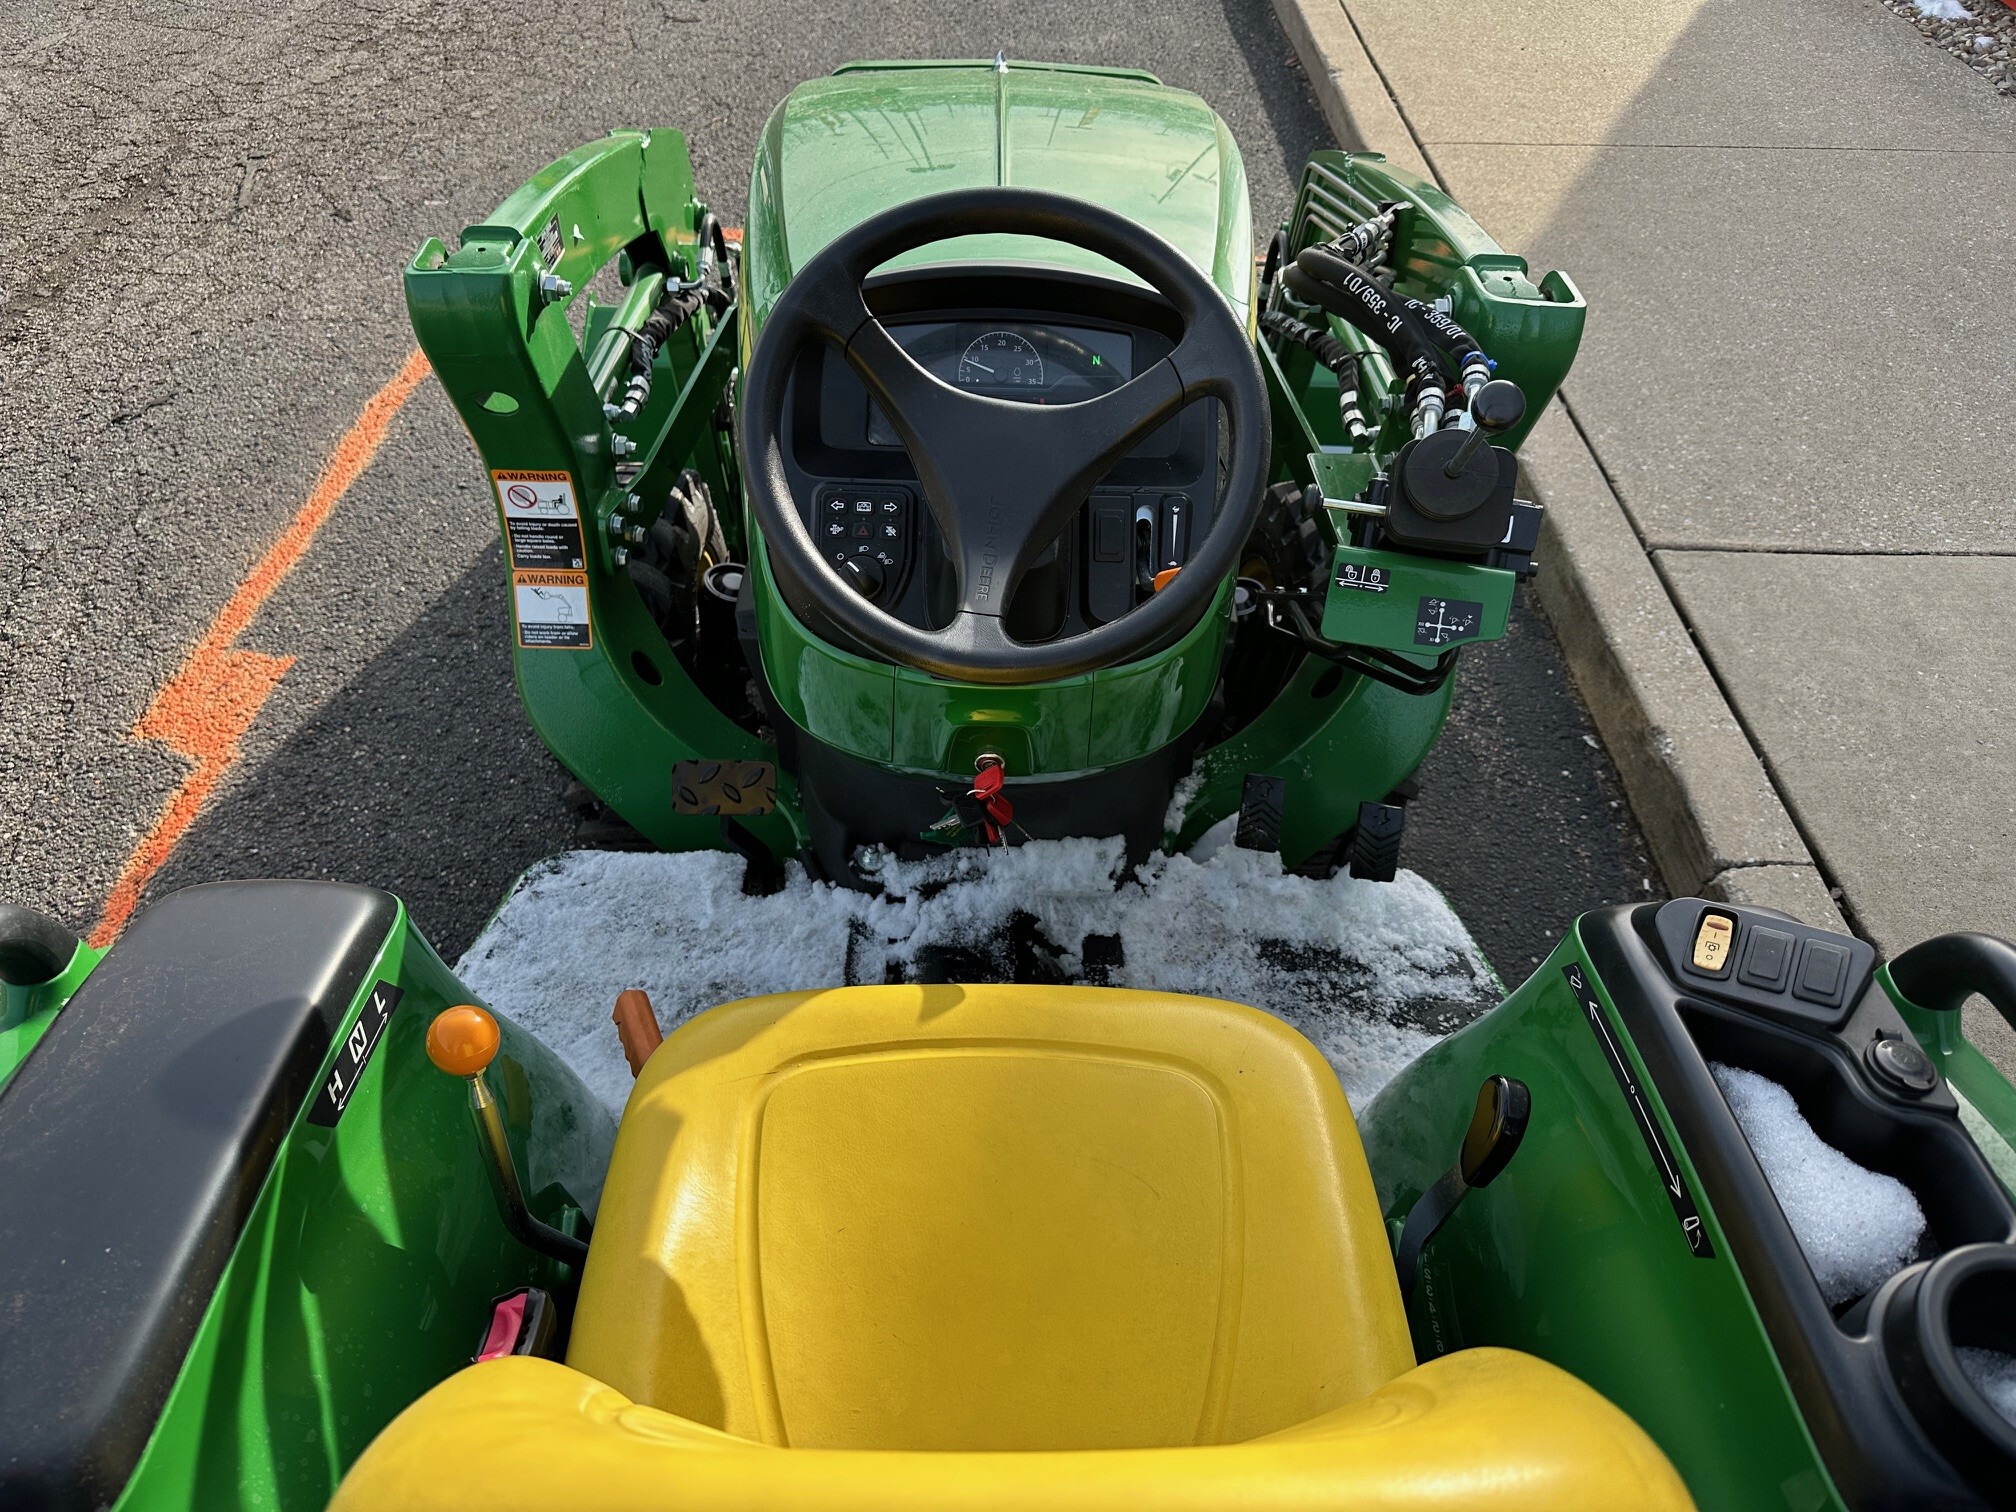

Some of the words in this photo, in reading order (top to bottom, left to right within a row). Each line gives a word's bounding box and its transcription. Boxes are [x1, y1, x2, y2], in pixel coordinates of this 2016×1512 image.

[1343, 272, 1386, 315] 359/01
[1387, 316, 1403, 333] IC
[1424, 310, 1466, 339] 359/01
[1092, 355, 1101, 365] N
[527, 575, 584, 584] WARNING
[975, 554, 997, 601] DEERE
[328, 1069, 343, 1104] H
[350, 1024, 366, 1060] N
[374, 991, 386, 1014] L
